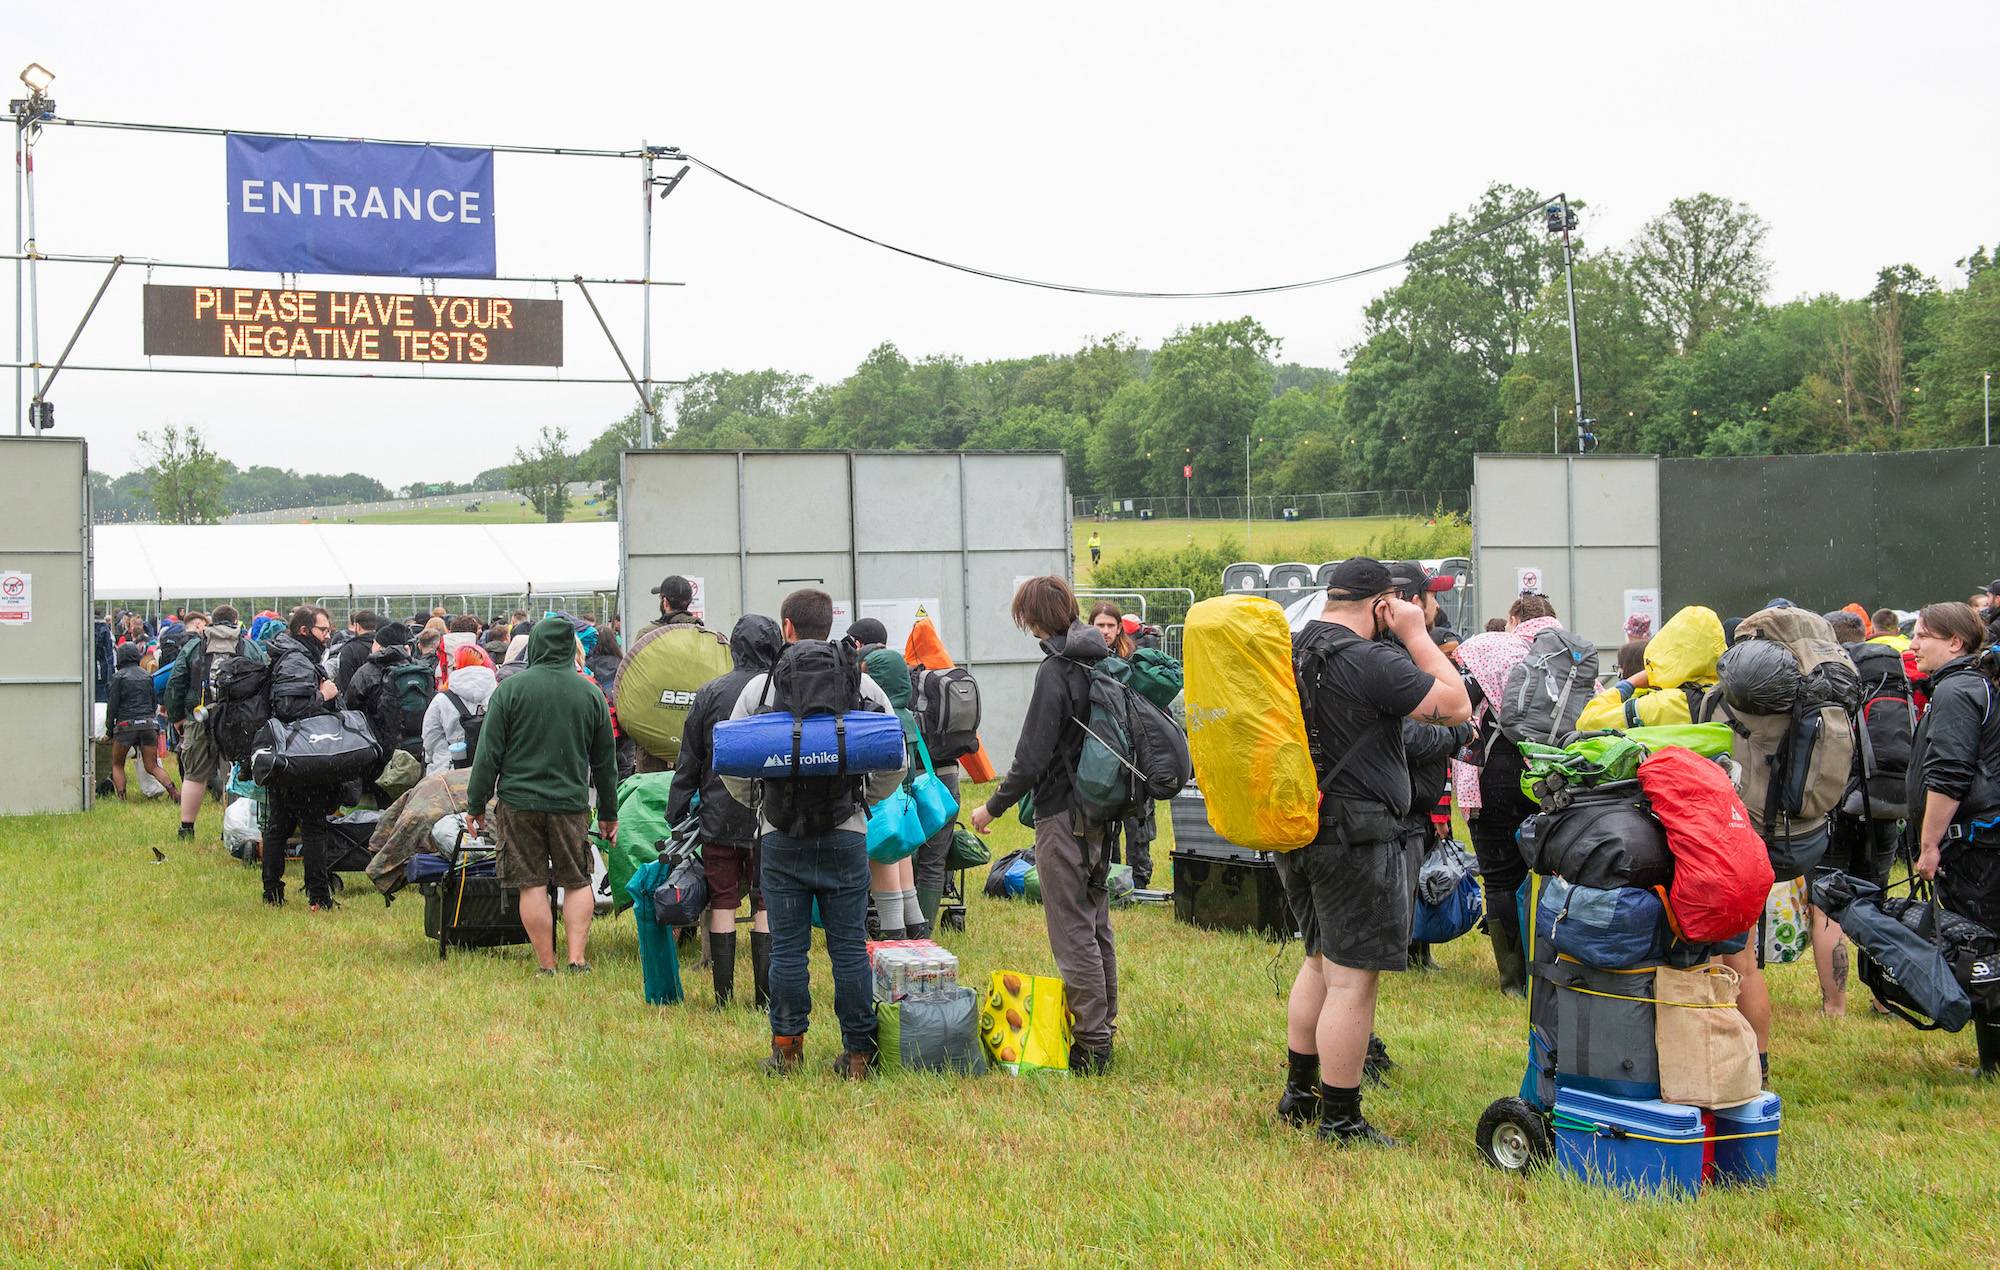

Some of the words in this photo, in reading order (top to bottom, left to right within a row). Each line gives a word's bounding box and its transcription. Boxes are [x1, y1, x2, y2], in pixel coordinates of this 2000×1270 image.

[242, 180, 482, 224] ENTRANCE
[195, 288, 317, 323] PLEASE
[330, 293, 415, 327] HAVE
[427, 298, 513, 330] YOUR
[224, 324, 380, 359] NEGATIVE
[392, 330, 489, 362] TESTS
[784, 751, 839, 766] Erohike
